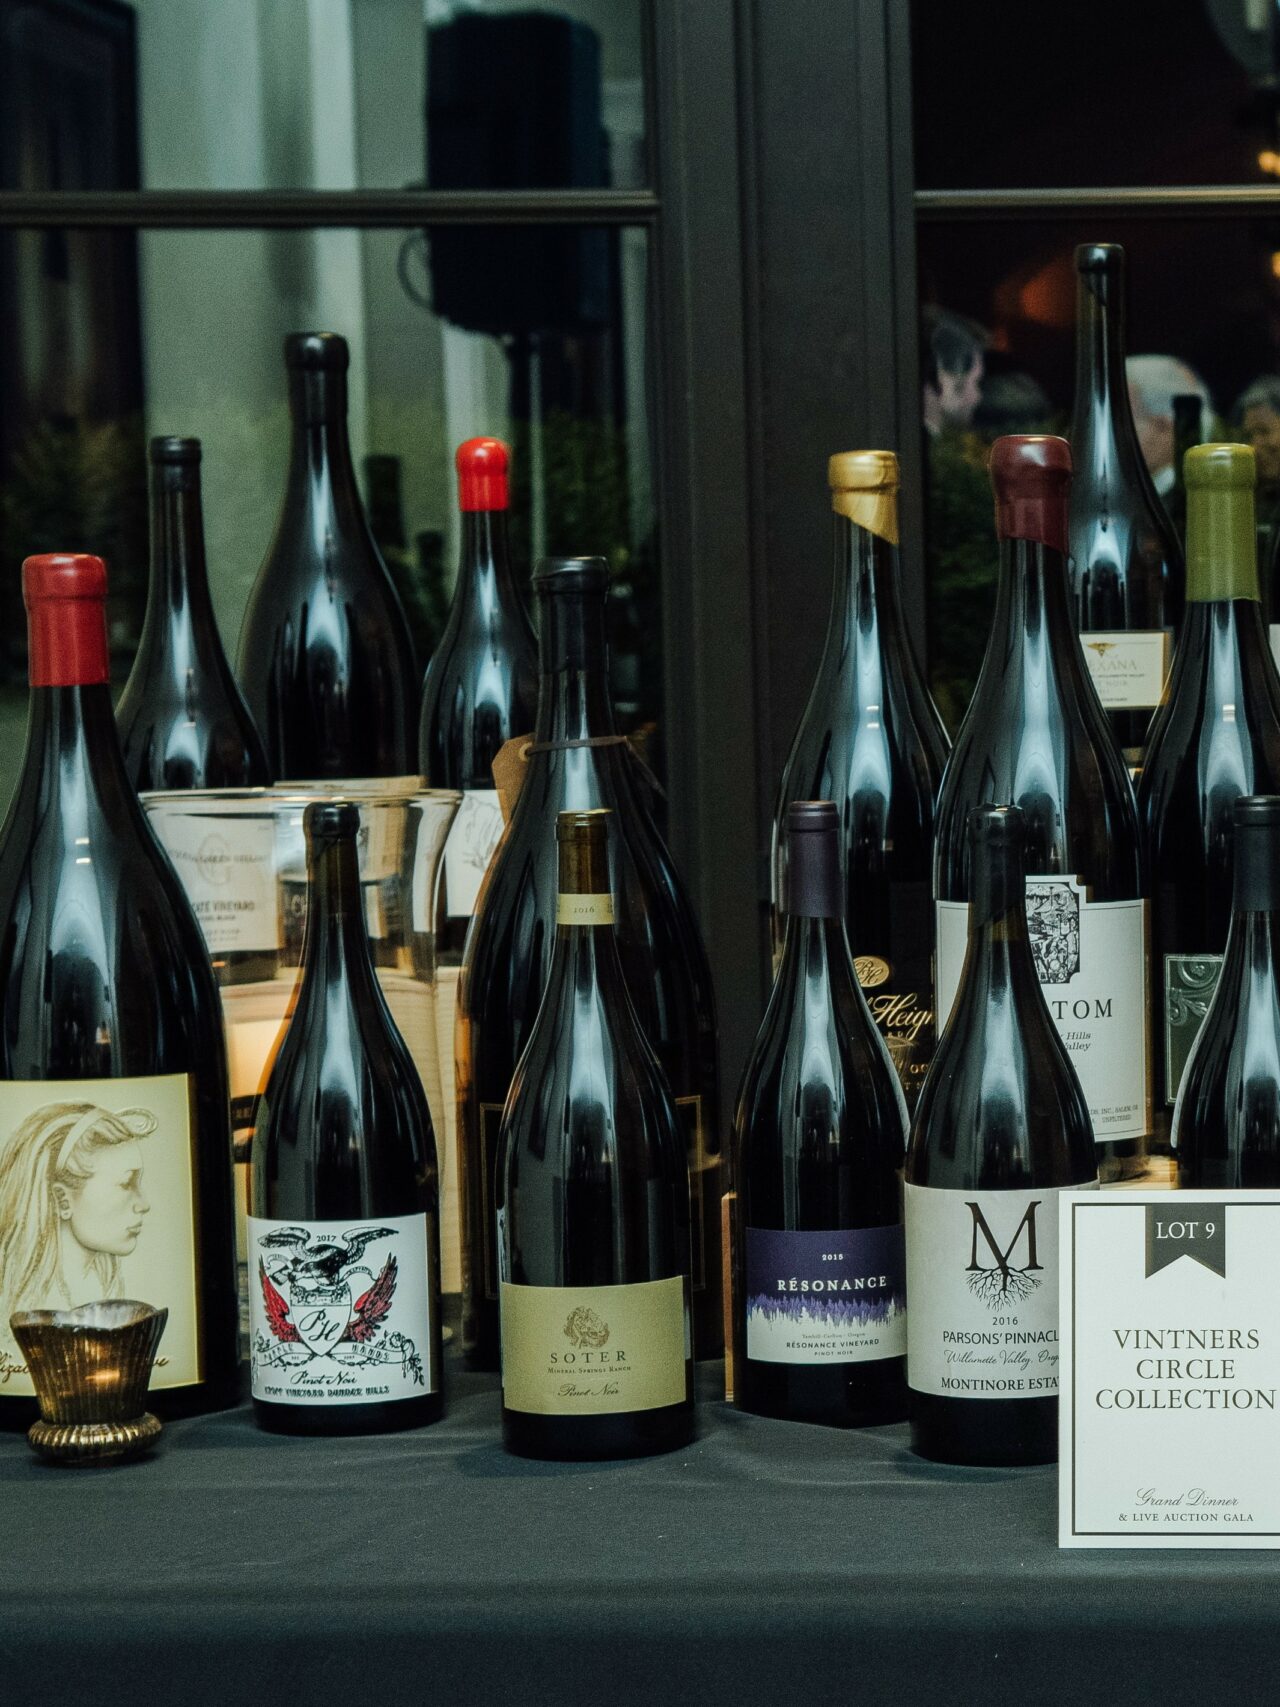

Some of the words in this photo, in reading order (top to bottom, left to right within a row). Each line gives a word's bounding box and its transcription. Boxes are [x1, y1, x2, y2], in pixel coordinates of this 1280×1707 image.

[1066, 1031, 1091, 1040] Hills
[1155, 1221, 1199, 1239] LOT
[1205, 1221, 1216, 1239] 9
[316, 1234, 337, 1243] 2017
[821, 1253, 844, 1261] 2015
[777, 1275, 888, 1292] RÉSONANCE
[992, 1316, 1019, 1326] 2016
[786, 1340, 837, 1349] RÉSONANCE
[840, 1338, 880, 1347] VINEYARD
[1004, 1330, 1059, 1344] PINNACL
[1113, 1328, 1261, 1350] VINTNERS
[550, 1350, 627, 1364] SOTER
[943, 1349, 998, 1365] Willamette
[1136, 1358, 1235, 1380] CIRCLE
[290, 1370, 325, 1385] Pinot
[325, 1370, 358, 1386] Noir
[941, 1376, 1025, 1391] MONTINORE
[1028, 1376, 1059, 1390] ESTA
[557, 1383, 591, 1397] Pinot
[591, 1381, 619, 1396] Noir
[1095, 1388, 1277, 1410] COLLECTION
[1135, 1487, 1182, 1507] Grand
[1188, 1487, 1240, 1507] Dinner
[1118, 1512, 1128, 1522] &
[1132, 1512, 1160, 1522] LIVE
[1163, 1512, 1219, 1522] AUCTION
[1223, 1512, 1255, 1522] GALA
